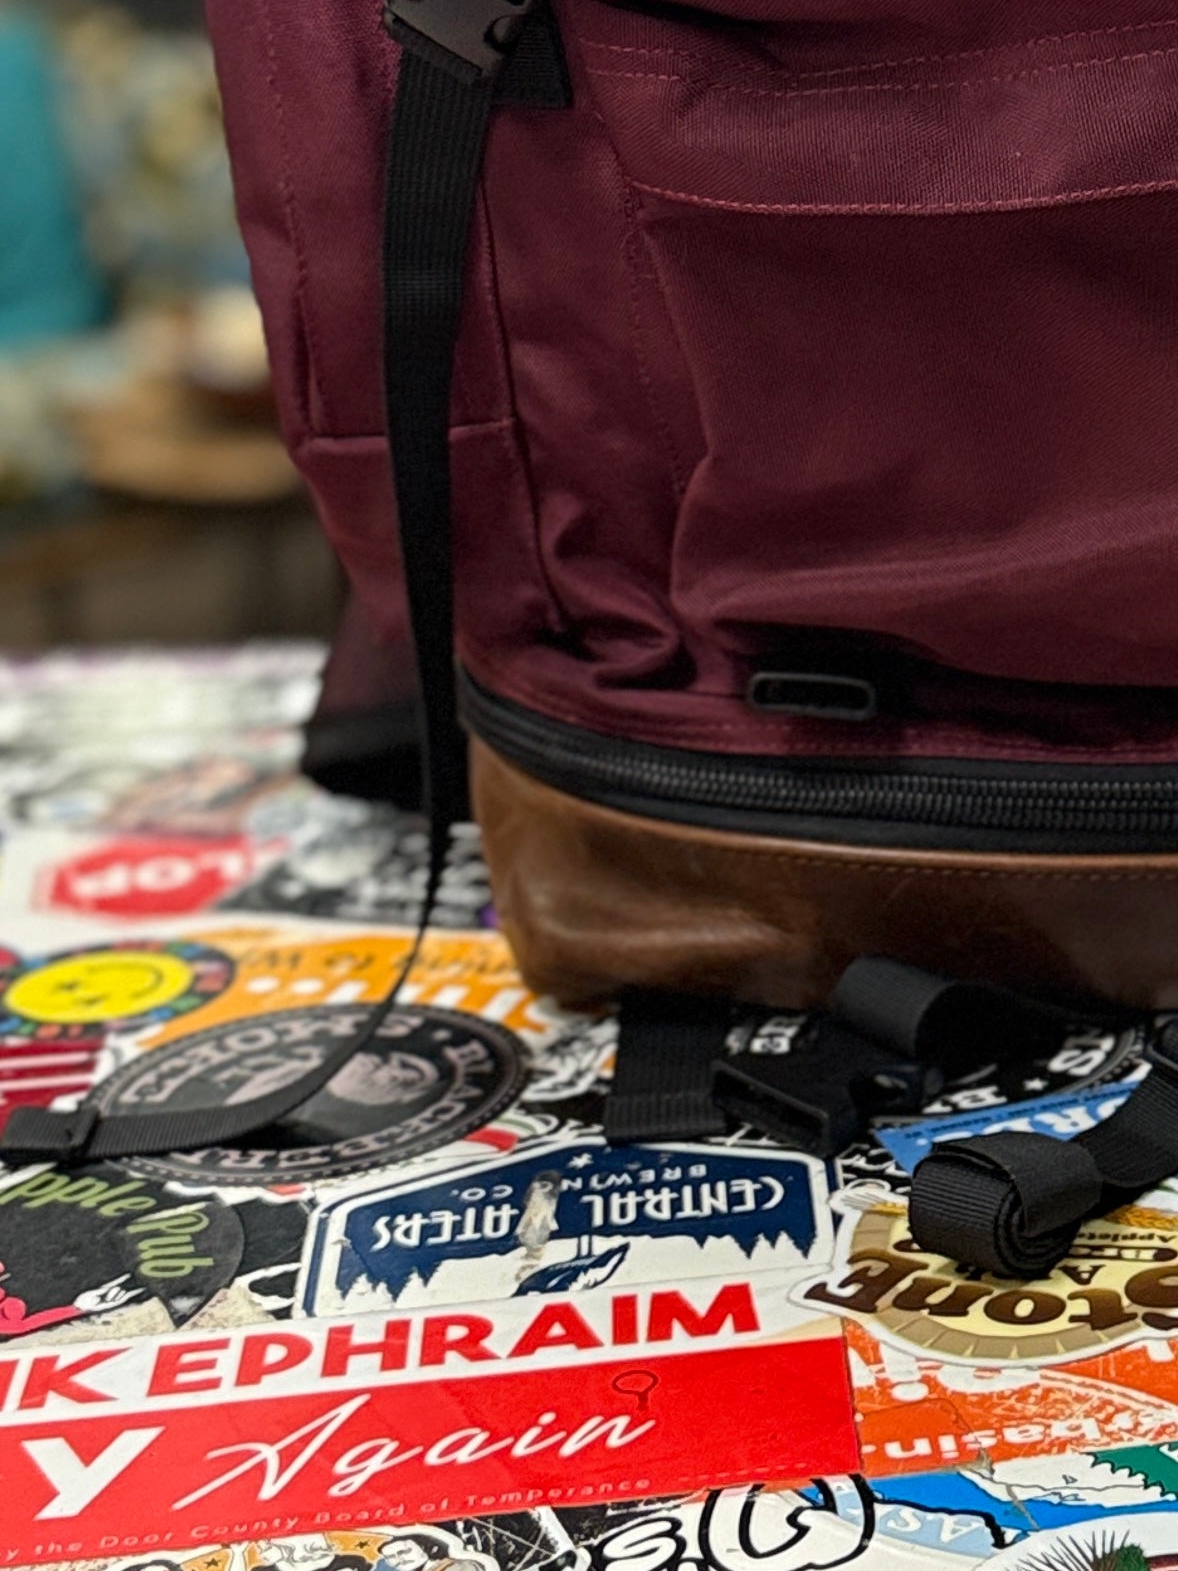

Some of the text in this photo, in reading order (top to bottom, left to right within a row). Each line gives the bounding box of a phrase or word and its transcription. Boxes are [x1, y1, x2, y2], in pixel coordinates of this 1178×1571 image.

[451, 1185, 514, 1202] CO.
[579, 1175, 786, 1229] CENTRAL
[126, 1208, 214, 1278] Pub
[145, 1282, 761, 1398] EPHRAIM
[170, 1392, 657, 1512] Again
[34, 1540, 83, 1556] the
[100, 1531, 174, 1549] Door
[190, 1516, 299, 1540] County
[314, 1504, 405, 1526] Board
[420, 1498, 450, 1511] of
[466, 1476, 652, 1508] Temperance
